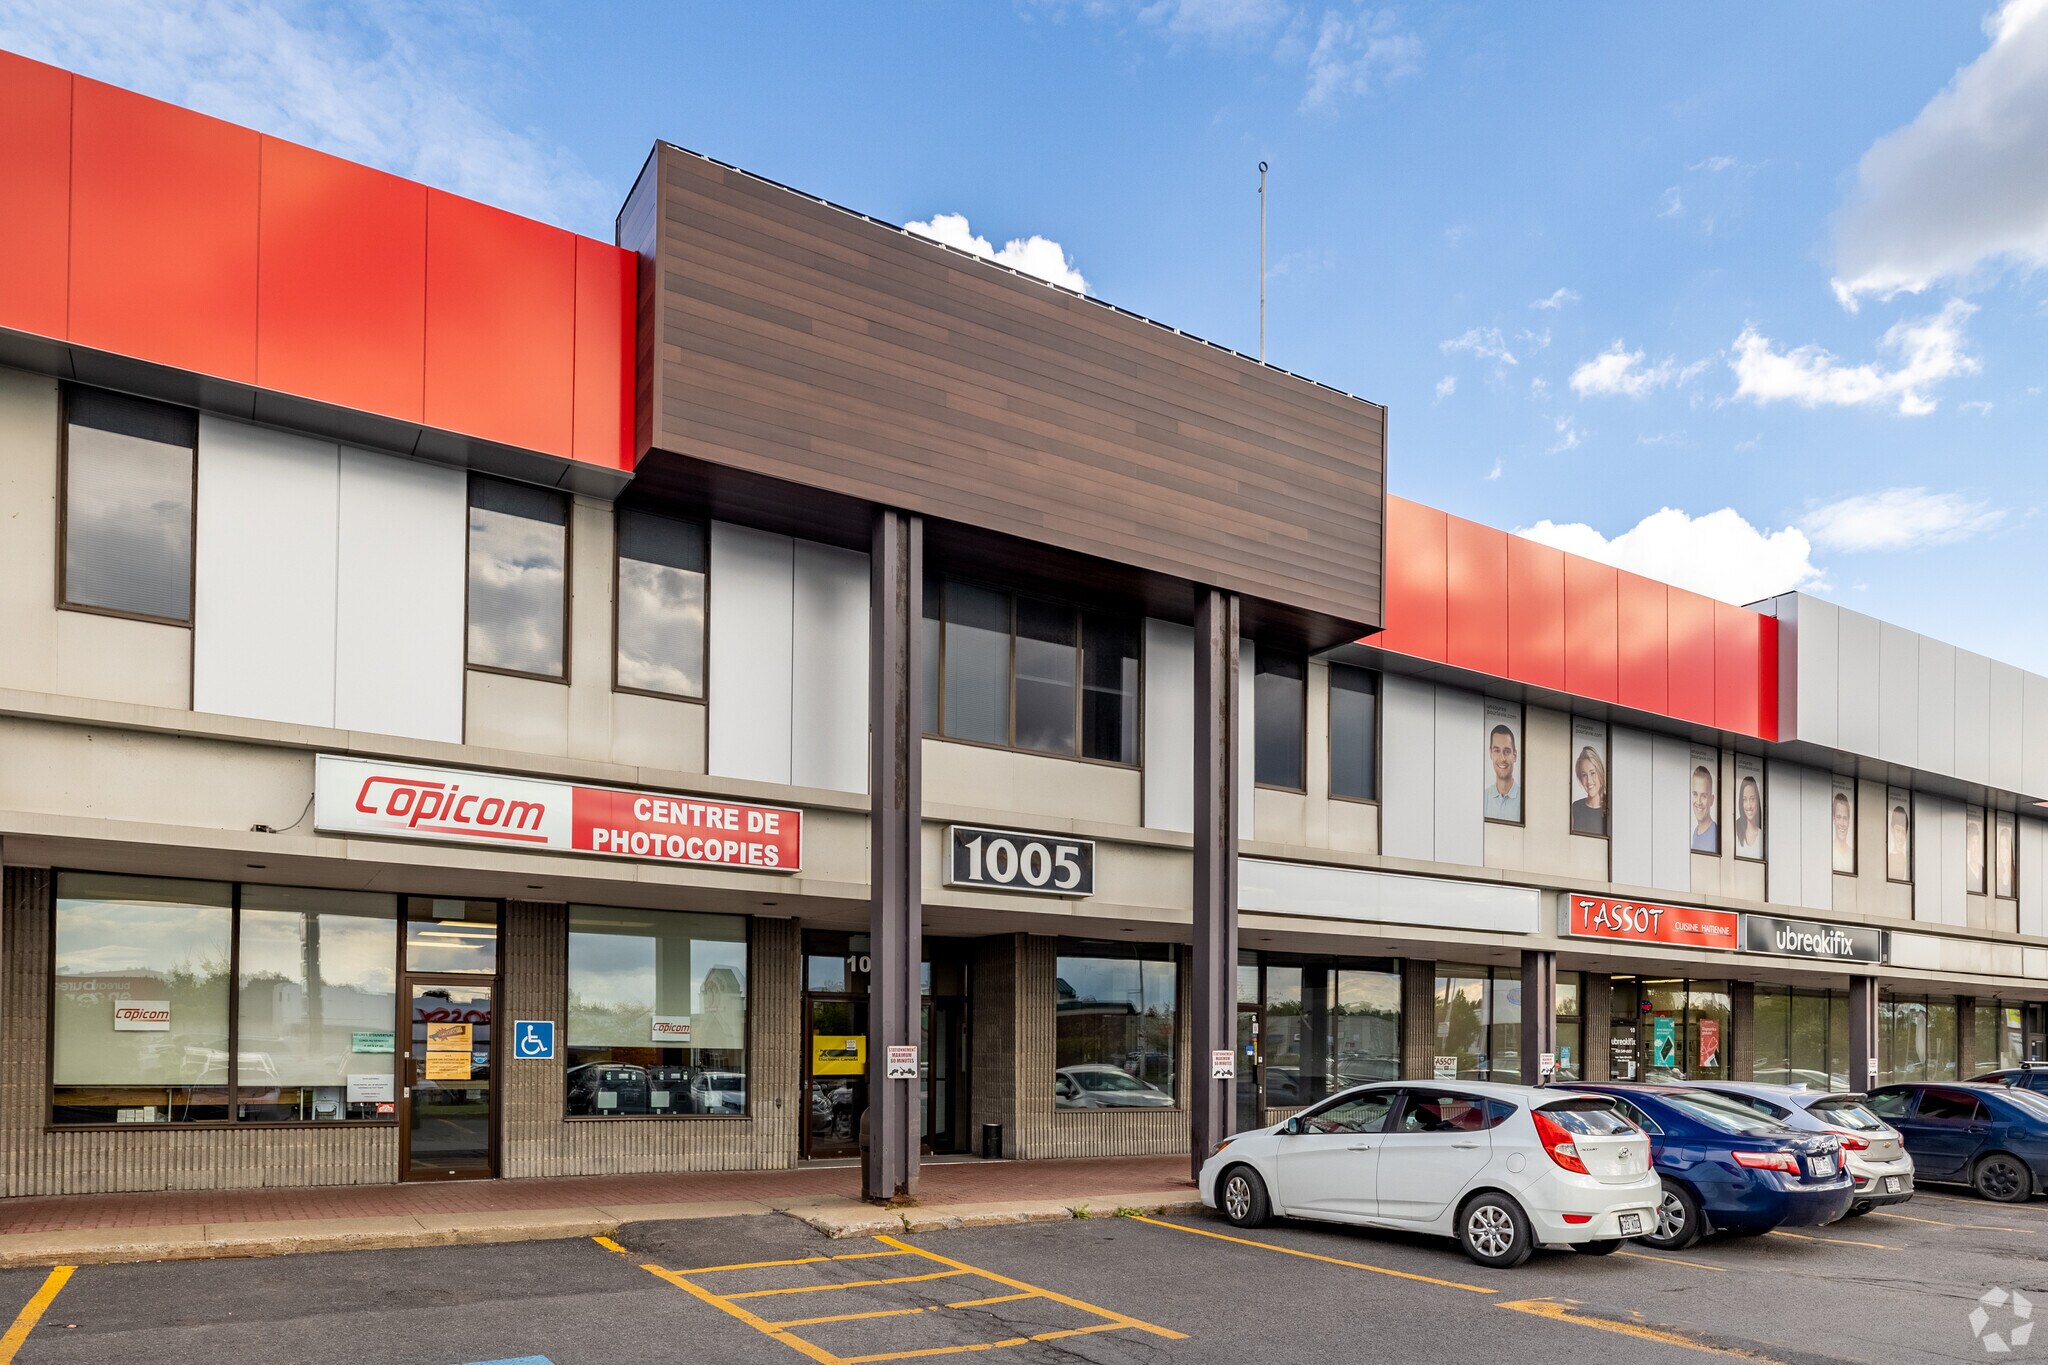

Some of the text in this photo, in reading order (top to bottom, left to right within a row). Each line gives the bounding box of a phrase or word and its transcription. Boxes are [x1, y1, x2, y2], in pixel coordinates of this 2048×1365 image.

[355, 776, 546, 831] Copicom
[633, 798, 780, 835] CENTRE DE
[592, 827, 779, 867] PHOTOCOPIES
[964, 835, 1081, 889] 1005
[1579, 900, 1664, 935] TASSOT
[1674, 921, 1699, 932] CUISINE
[1776, 926, 1853, 956] ubreakifix
[115, 1008, 170, 1021] Copicom
[652, 1022, 690, 1034] Copicom
